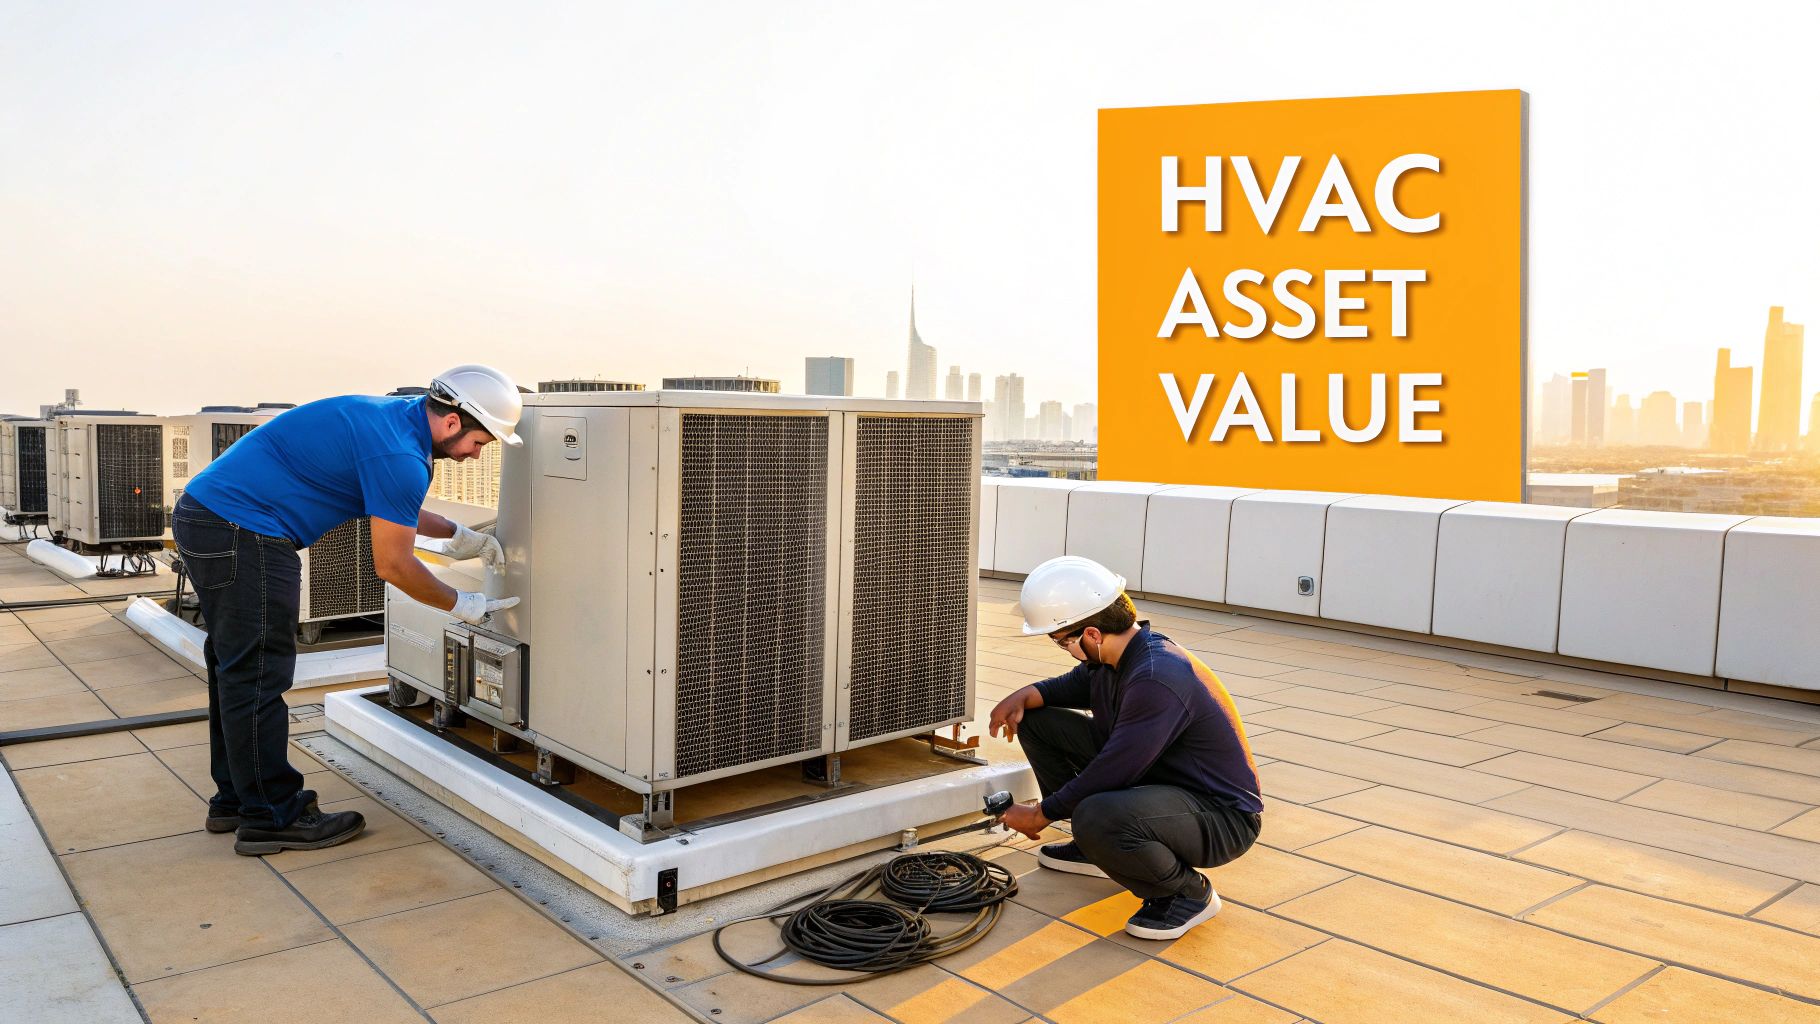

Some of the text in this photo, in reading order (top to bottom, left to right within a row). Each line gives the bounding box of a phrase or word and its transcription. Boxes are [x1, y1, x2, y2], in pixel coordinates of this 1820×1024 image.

[1161, 154, 1441, 234] HVAC
[1157, 268, 1427, 340] ASSET
[1160, 372, 1444, 443] VALUE
